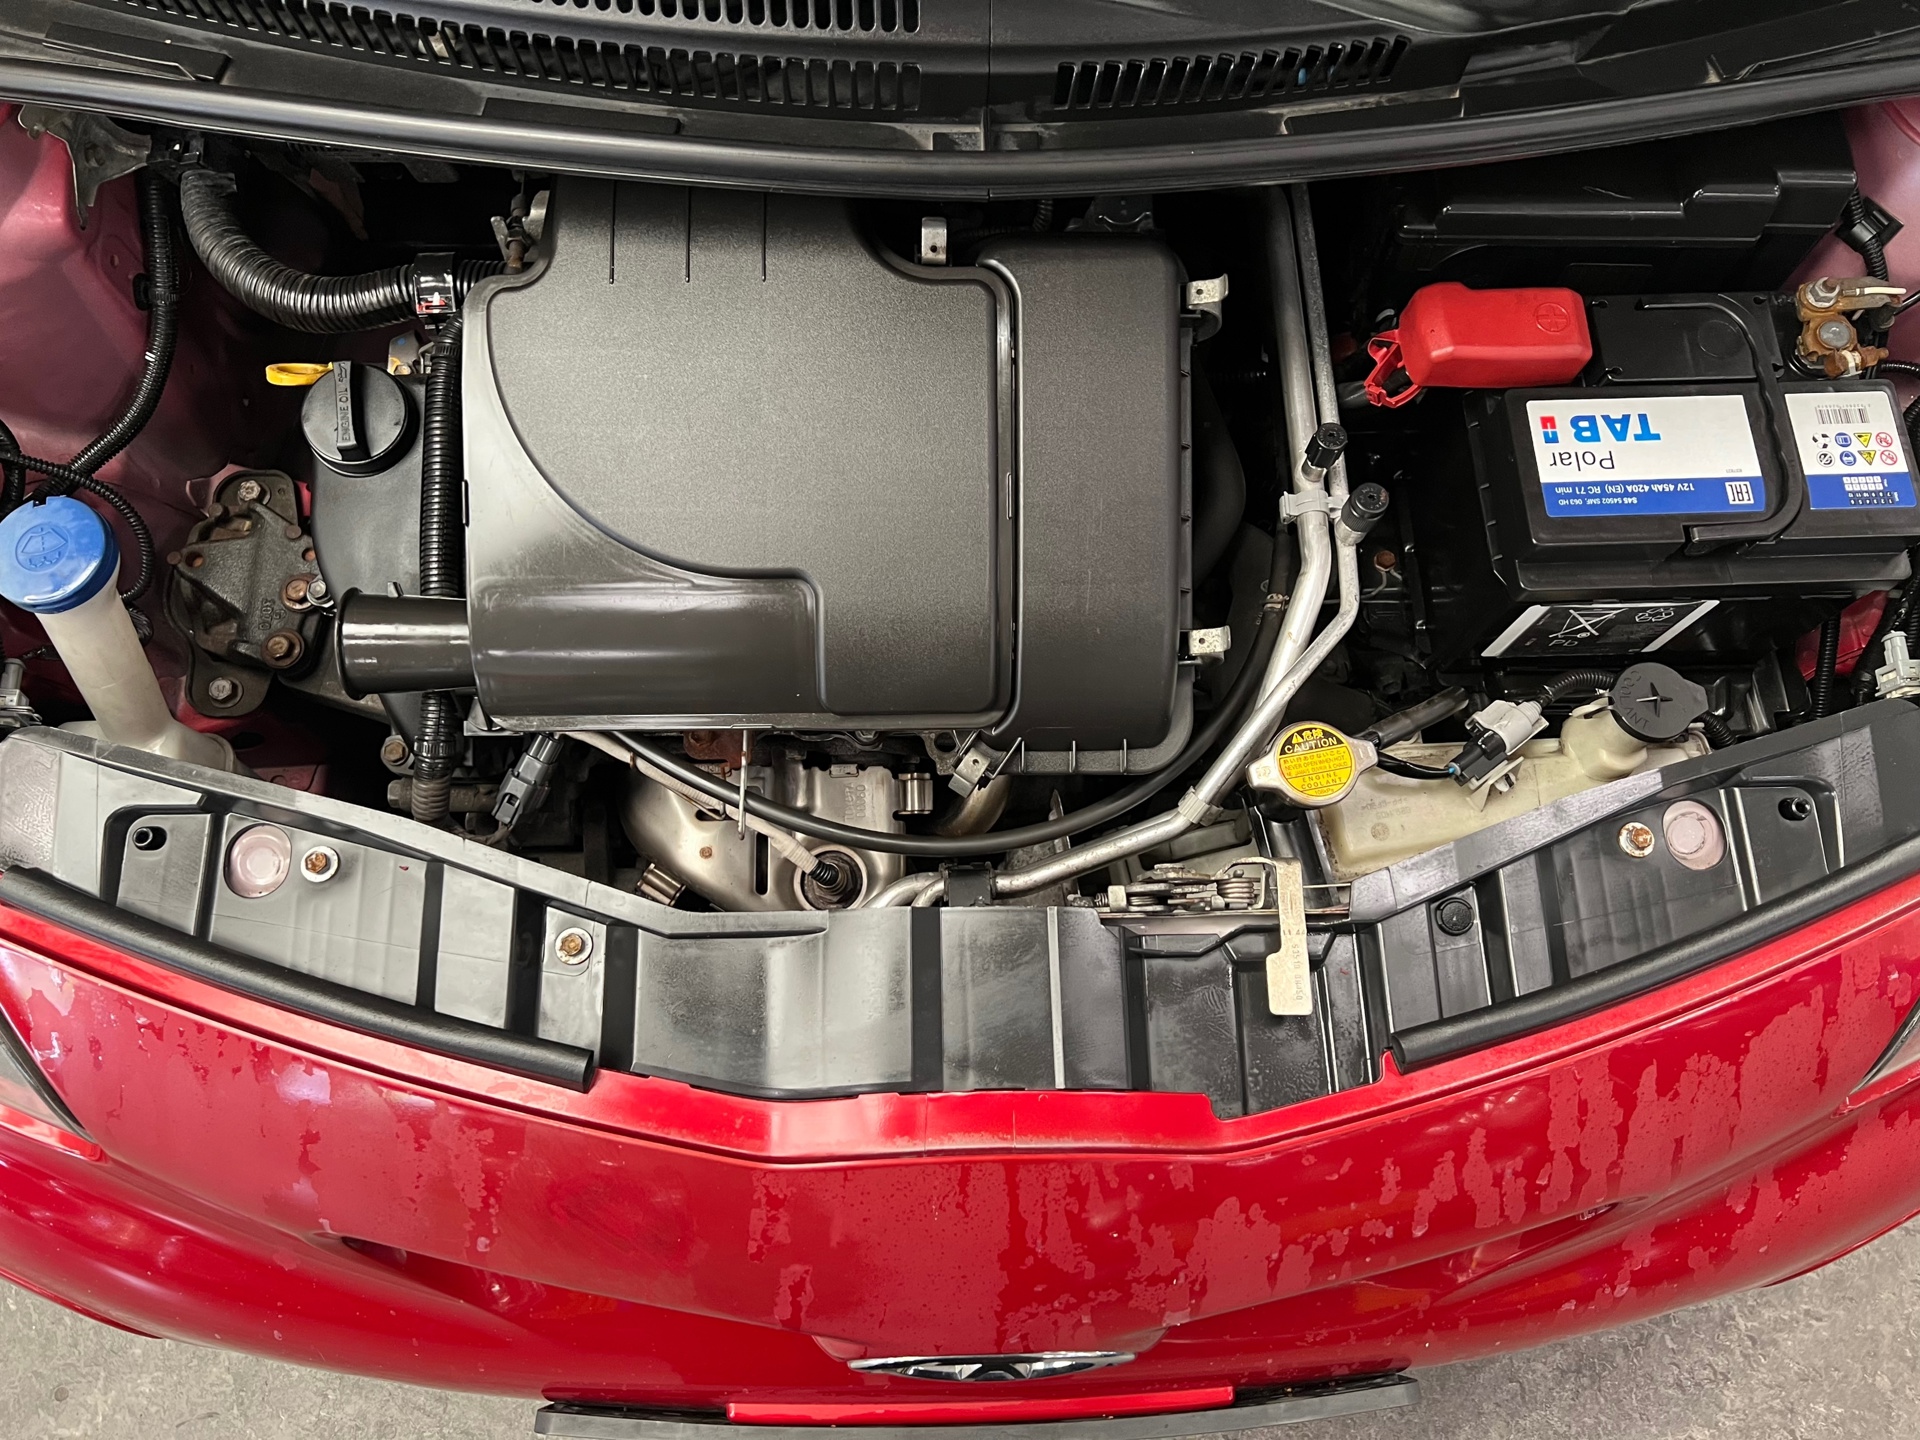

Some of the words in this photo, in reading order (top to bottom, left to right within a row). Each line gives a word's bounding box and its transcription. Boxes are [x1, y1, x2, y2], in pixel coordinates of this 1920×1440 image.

[338, 387, 348, 403] OIL
[339, 405, 351, 441] ENGINE
[1570, 413, 1662, 443] TAB
[1550, 450, 1615, 471] Polar
[1555, 487, 1572, 495] min
[1587, 486, 1601, 494] RC
[1605, 484, 1624, 494] (EN)
[1626, 484, 1649, 493] 420A
[1652, 483, 1675, 492] 45Ah
[1677, 482, 1694, 492] 12V
[1619, 670, 1650, 730] COOLANT
[1302, 728, 1324, 741] 危険
[1285, 736, 1337, 754] CAUTION
[1285, 763, 1303, 771] NEVER
[1319, 758, 1333, 766] WHEN
[1301, 777, 1342, 790] COOLANT
[1302, 772, 1338, 783] ENGINE
